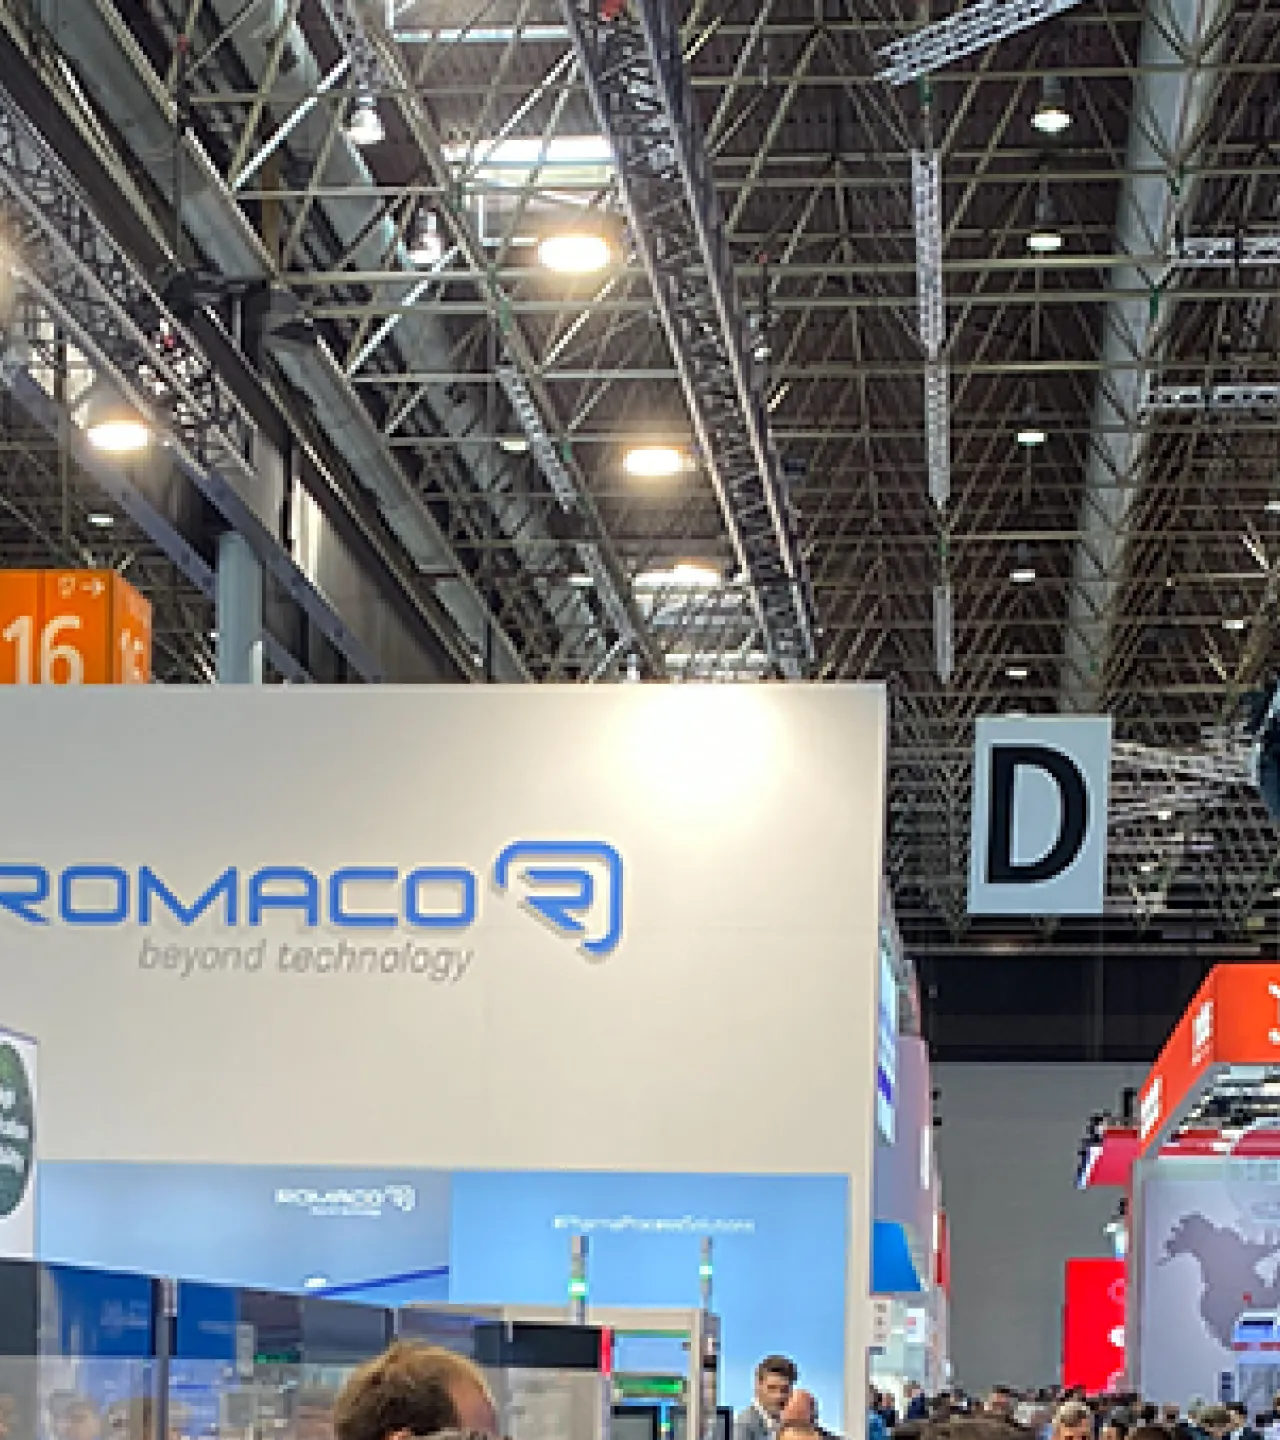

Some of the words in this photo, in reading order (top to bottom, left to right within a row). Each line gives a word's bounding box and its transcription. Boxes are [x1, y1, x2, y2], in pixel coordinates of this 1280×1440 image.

[3, 615, 84, 684] 16
[984, 742, 1091, 885] D
[138, 938, 267, 979] beyond
[277, 941, 477, 982] technology
